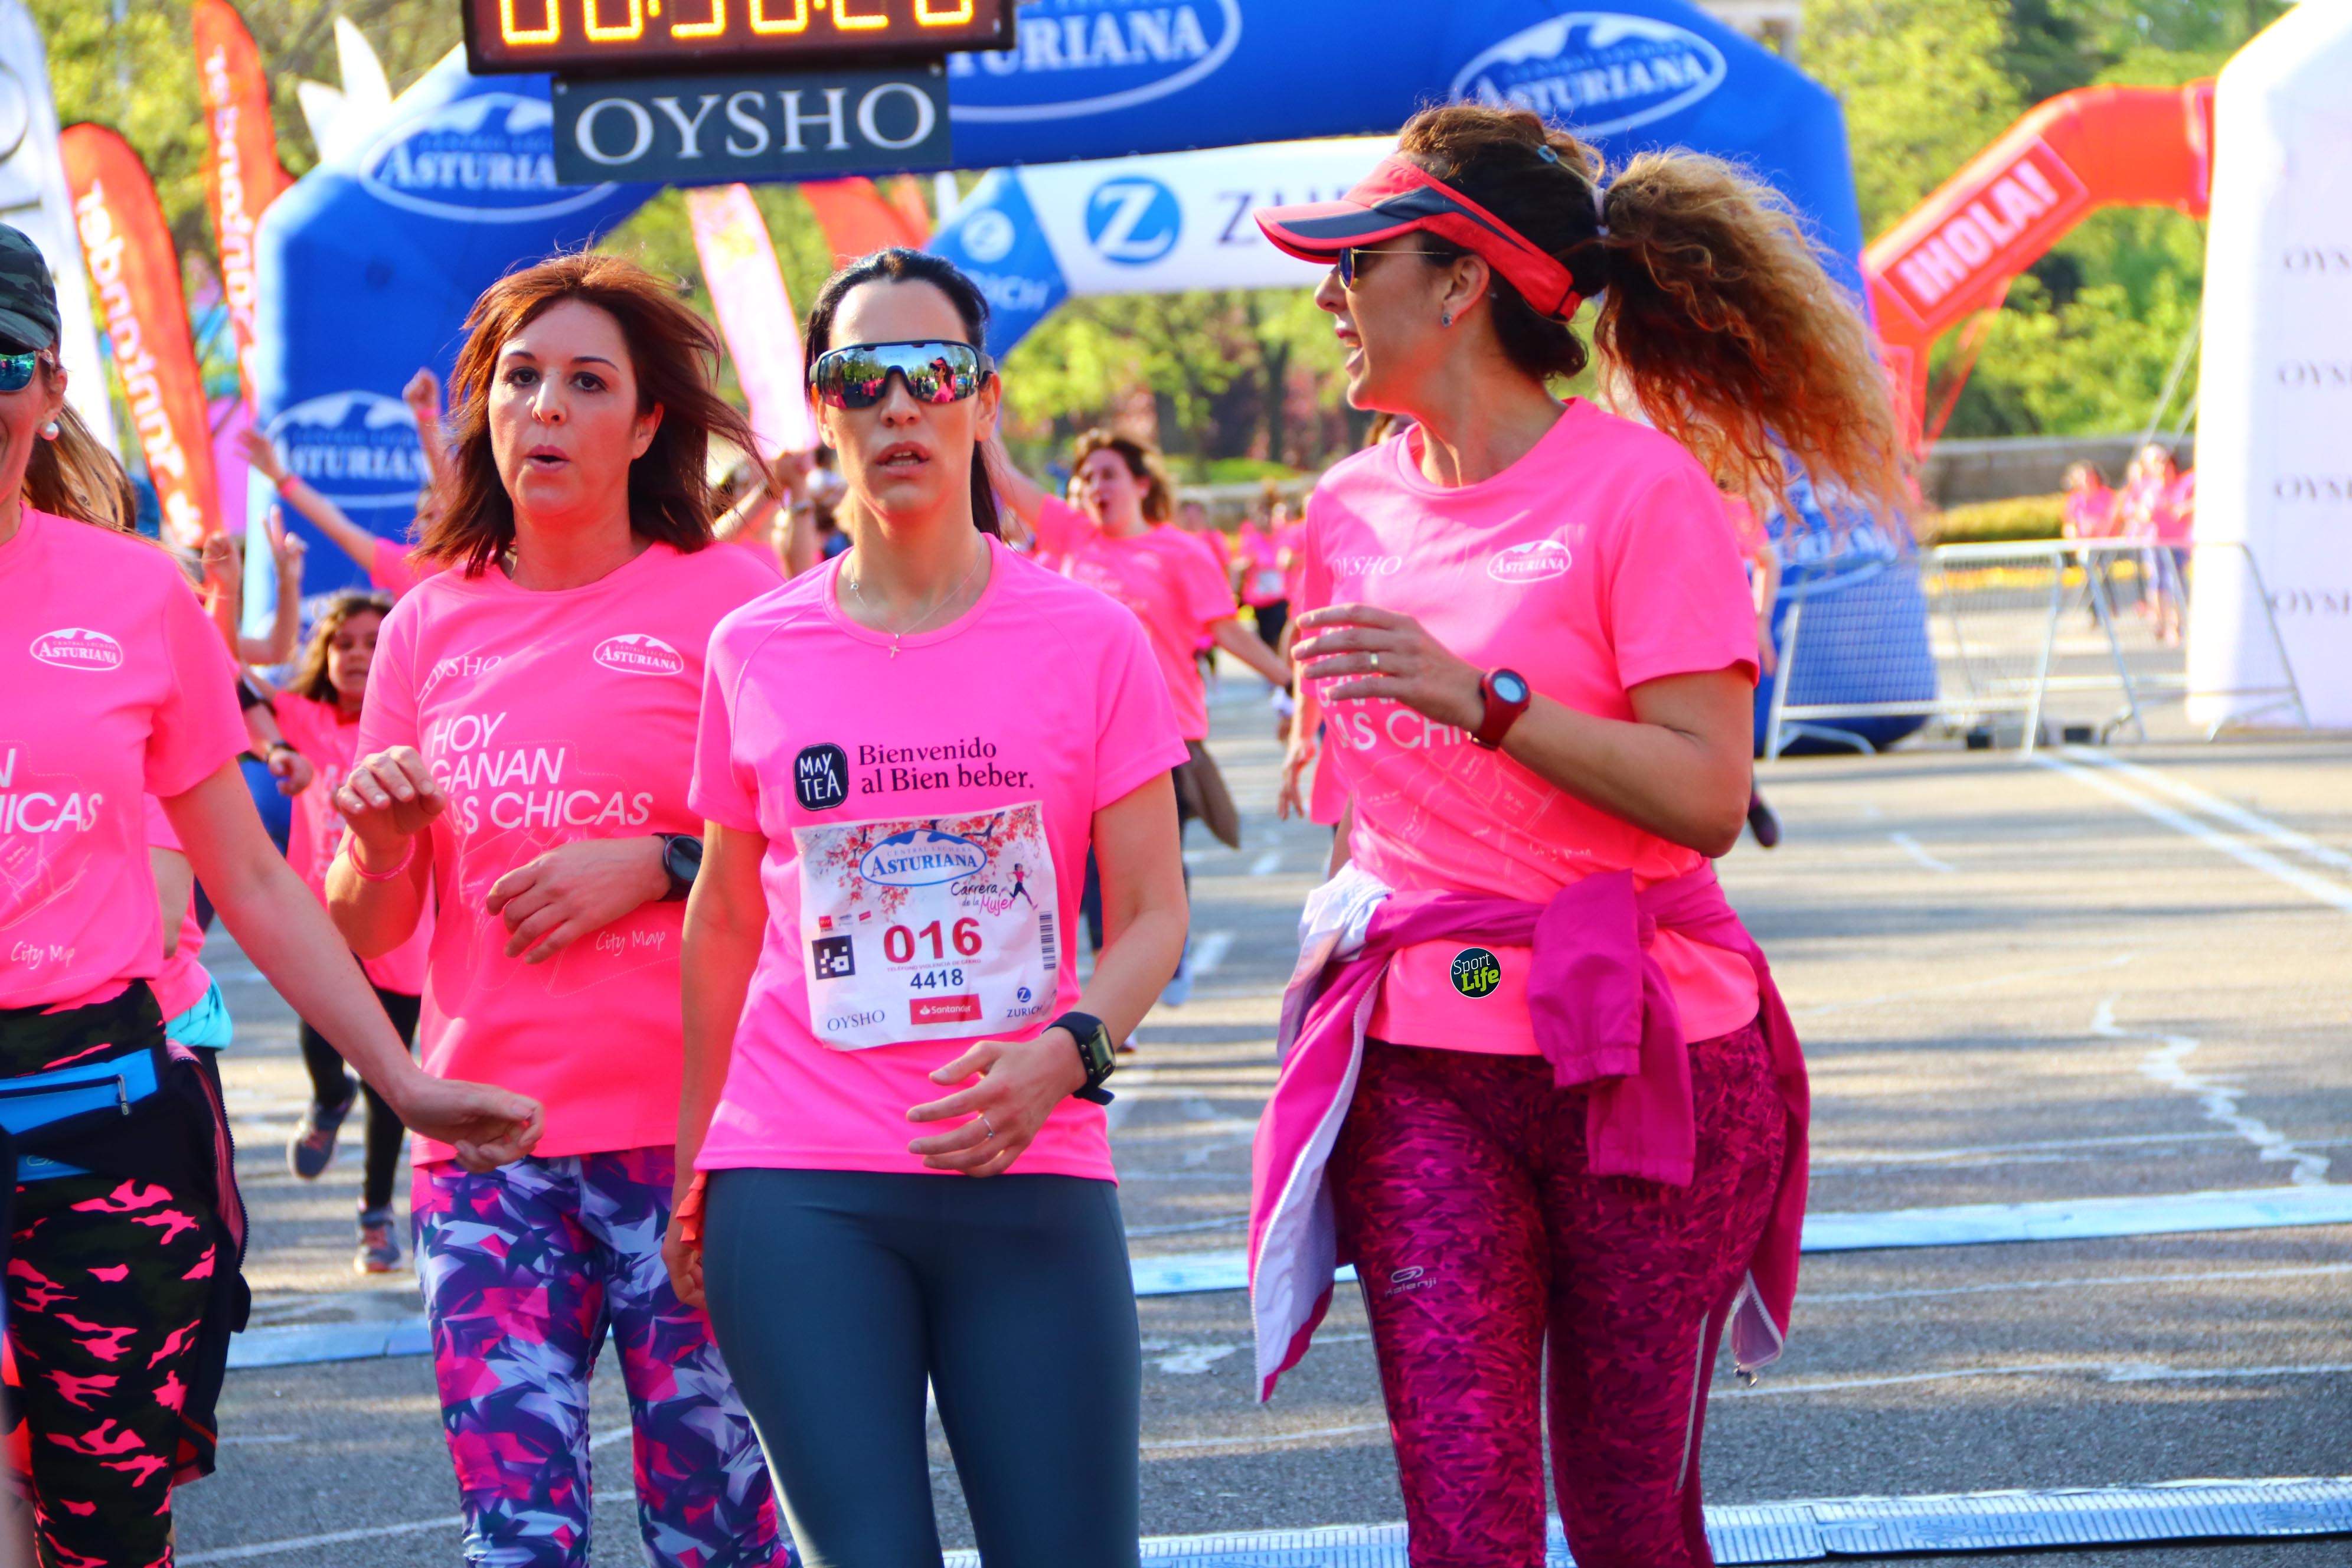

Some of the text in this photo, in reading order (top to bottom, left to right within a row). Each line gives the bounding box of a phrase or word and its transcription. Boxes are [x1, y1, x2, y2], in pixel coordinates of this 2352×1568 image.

[1477, 53, 1707, 115] ASTURIANA
[576, 83, 935, 165] OYSHO
[379, 142, 557, 189] ASTURIA
[1333, 555, 1402, 576] OYSHO
[1492, 557, 1564, 573] ASTURIANA
[38, 641, 117, 664] ASTURIANA
[600, 646, 677, 671] ASTURIANA
[430, 712, 507, 757] HOY
[1335, 712, 1377, 750] AS
[858, 736, 997, 766] Bienvenido
[430, 747, 565, 794] GANAN
[799, 753, 832, 778] MAY
[861, 762, 1034, 794] al Bien beber.
[801, 770, 841, 801] TEA
[0, 792, 103, 834] ICAS
[450, 790, 653, 835] AS CHICAS
[871, 852, 978, 877] ASTURIANA
[887, 847, 927, 856] CENTRAL
[951, 882, 998, 896] Carrera
[962, 894, 1015, 916] de la Mujer
[596, 930, 665, 956] City Map
[884, 917, 982, 963] 016
[11, 941, 75, 970] City Mp
[1453, 953, 1491, 975] Sport
[910, 968, 963, 989] 4418
[1461, 966, 1500, 992] Life
[827, 1010, 885, 1031] OYSHO
[931, 1005, 971, 1014] Santander
[1007, 1005, 1043, 1018] ZURICH
